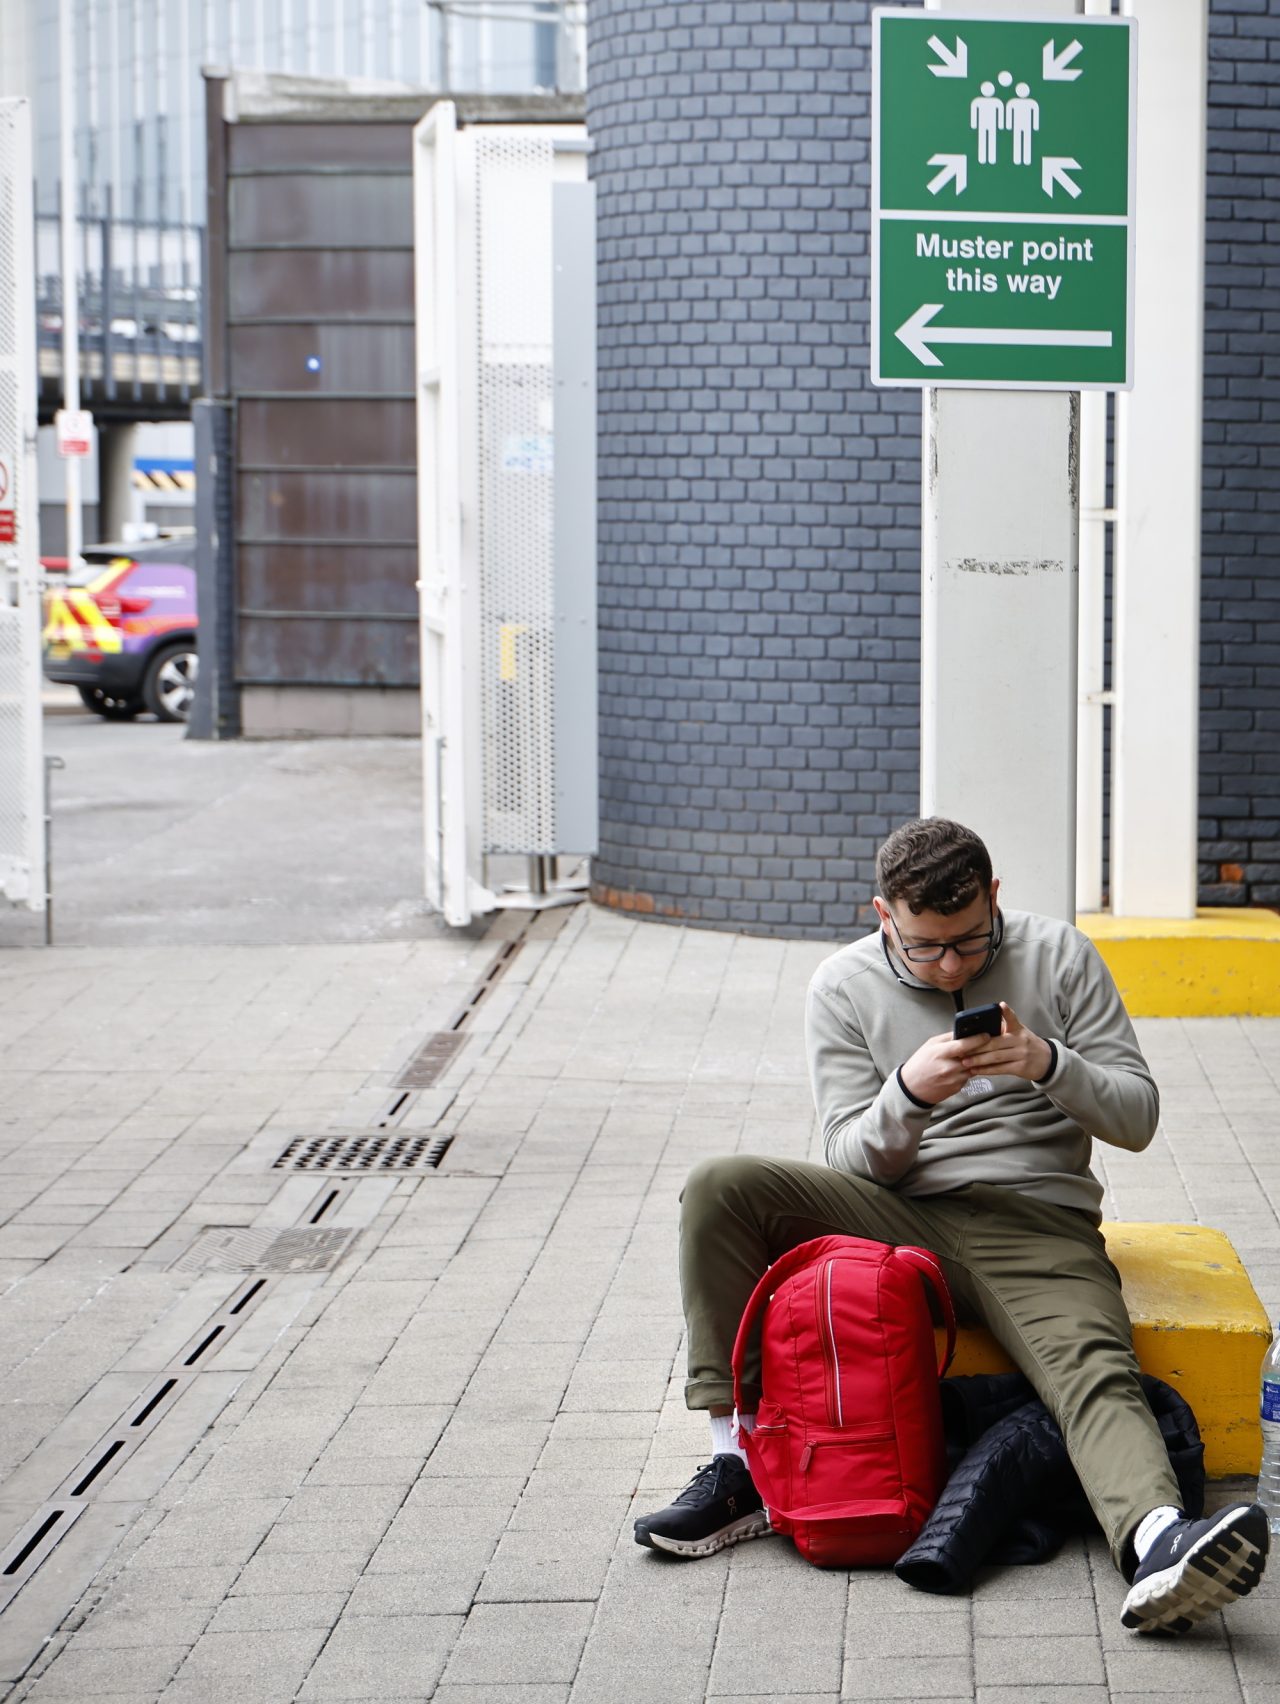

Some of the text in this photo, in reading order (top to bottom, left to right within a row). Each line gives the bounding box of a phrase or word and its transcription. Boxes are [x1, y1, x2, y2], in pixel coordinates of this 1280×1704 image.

[915, 233, 1094, 266] Muster point
[946, 268, 1062, 300] this way
